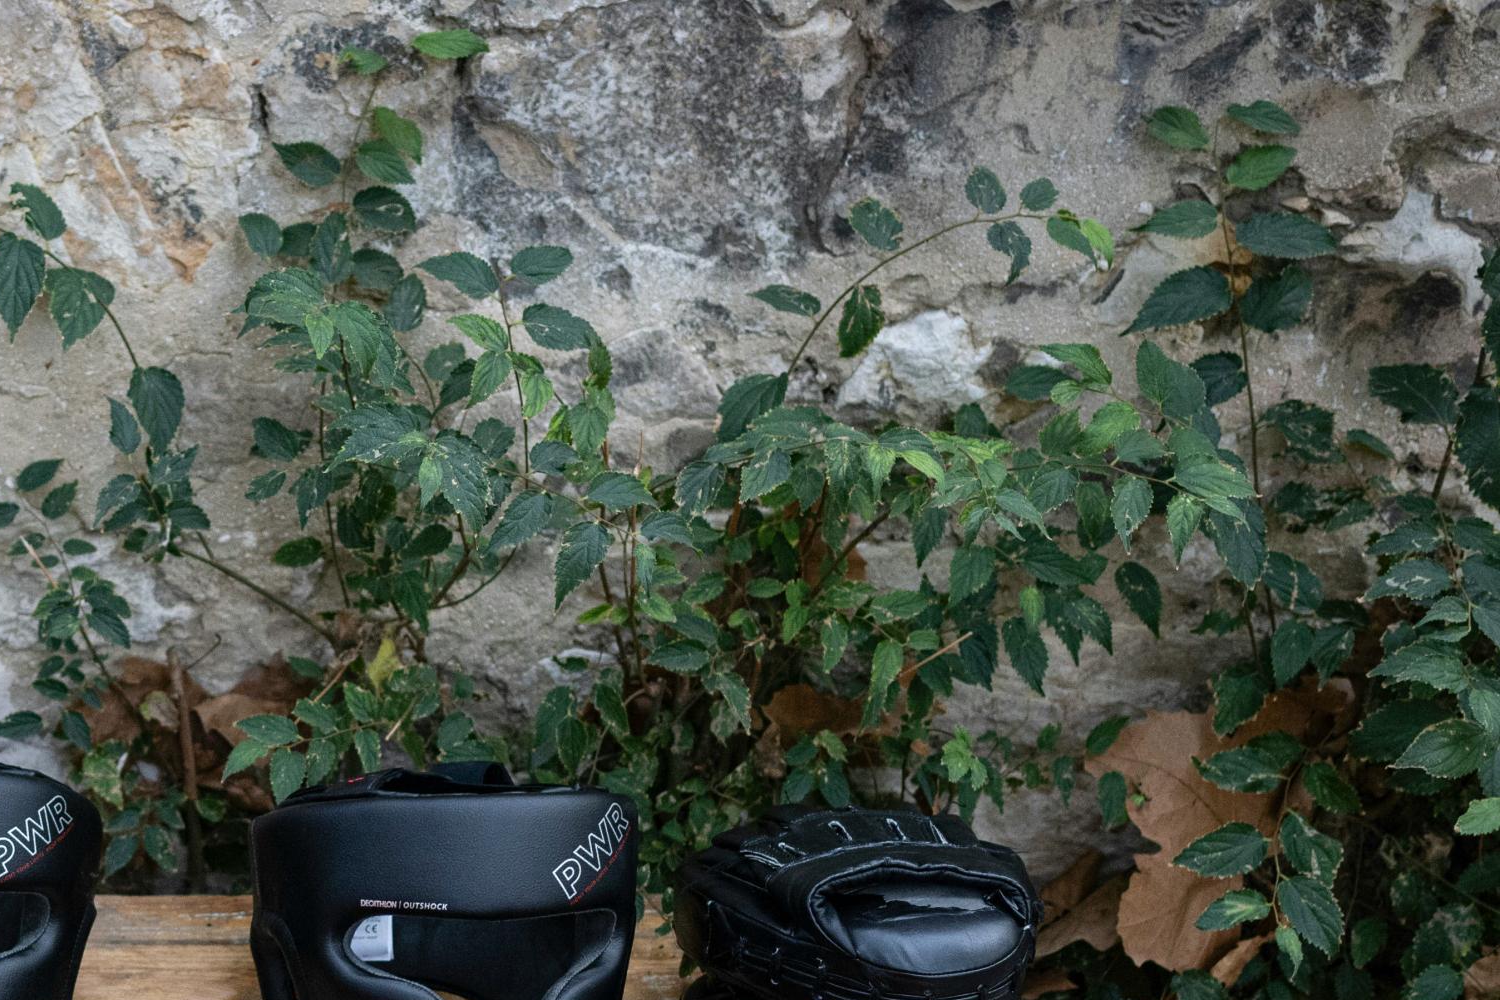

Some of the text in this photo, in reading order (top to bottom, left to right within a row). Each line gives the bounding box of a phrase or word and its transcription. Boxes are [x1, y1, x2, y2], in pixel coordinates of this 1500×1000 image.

[552, 802, 629, 900] PWR
[360, 899, 448, 911] DECATHLON OUTSHOCK
